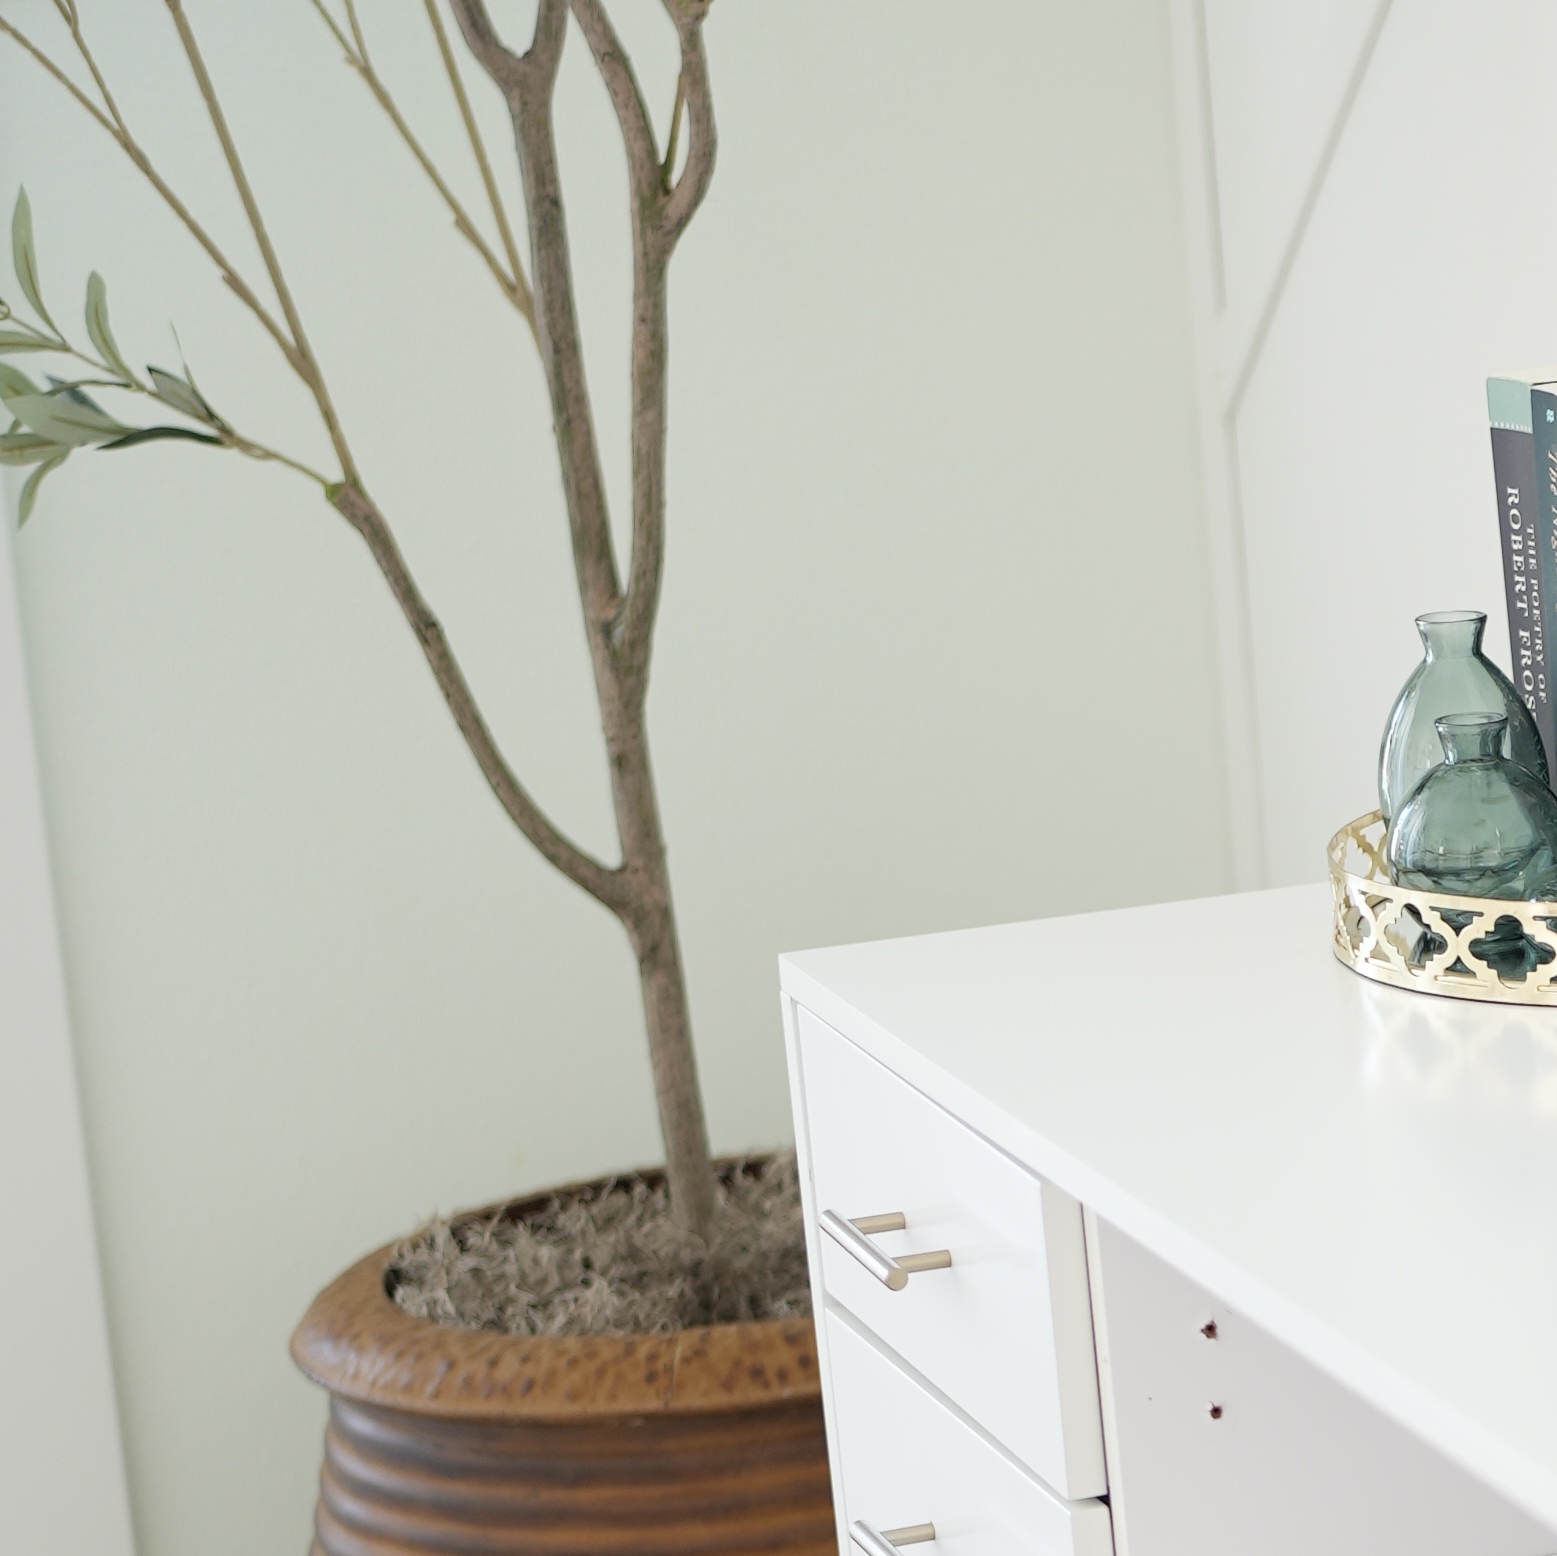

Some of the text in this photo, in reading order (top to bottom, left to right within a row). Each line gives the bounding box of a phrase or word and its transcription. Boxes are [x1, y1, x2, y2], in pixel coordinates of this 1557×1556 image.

[1506, 486, 1538, 722] ROBERT FROS
[1526, 523, 1548, 704] THE POETRY OF
